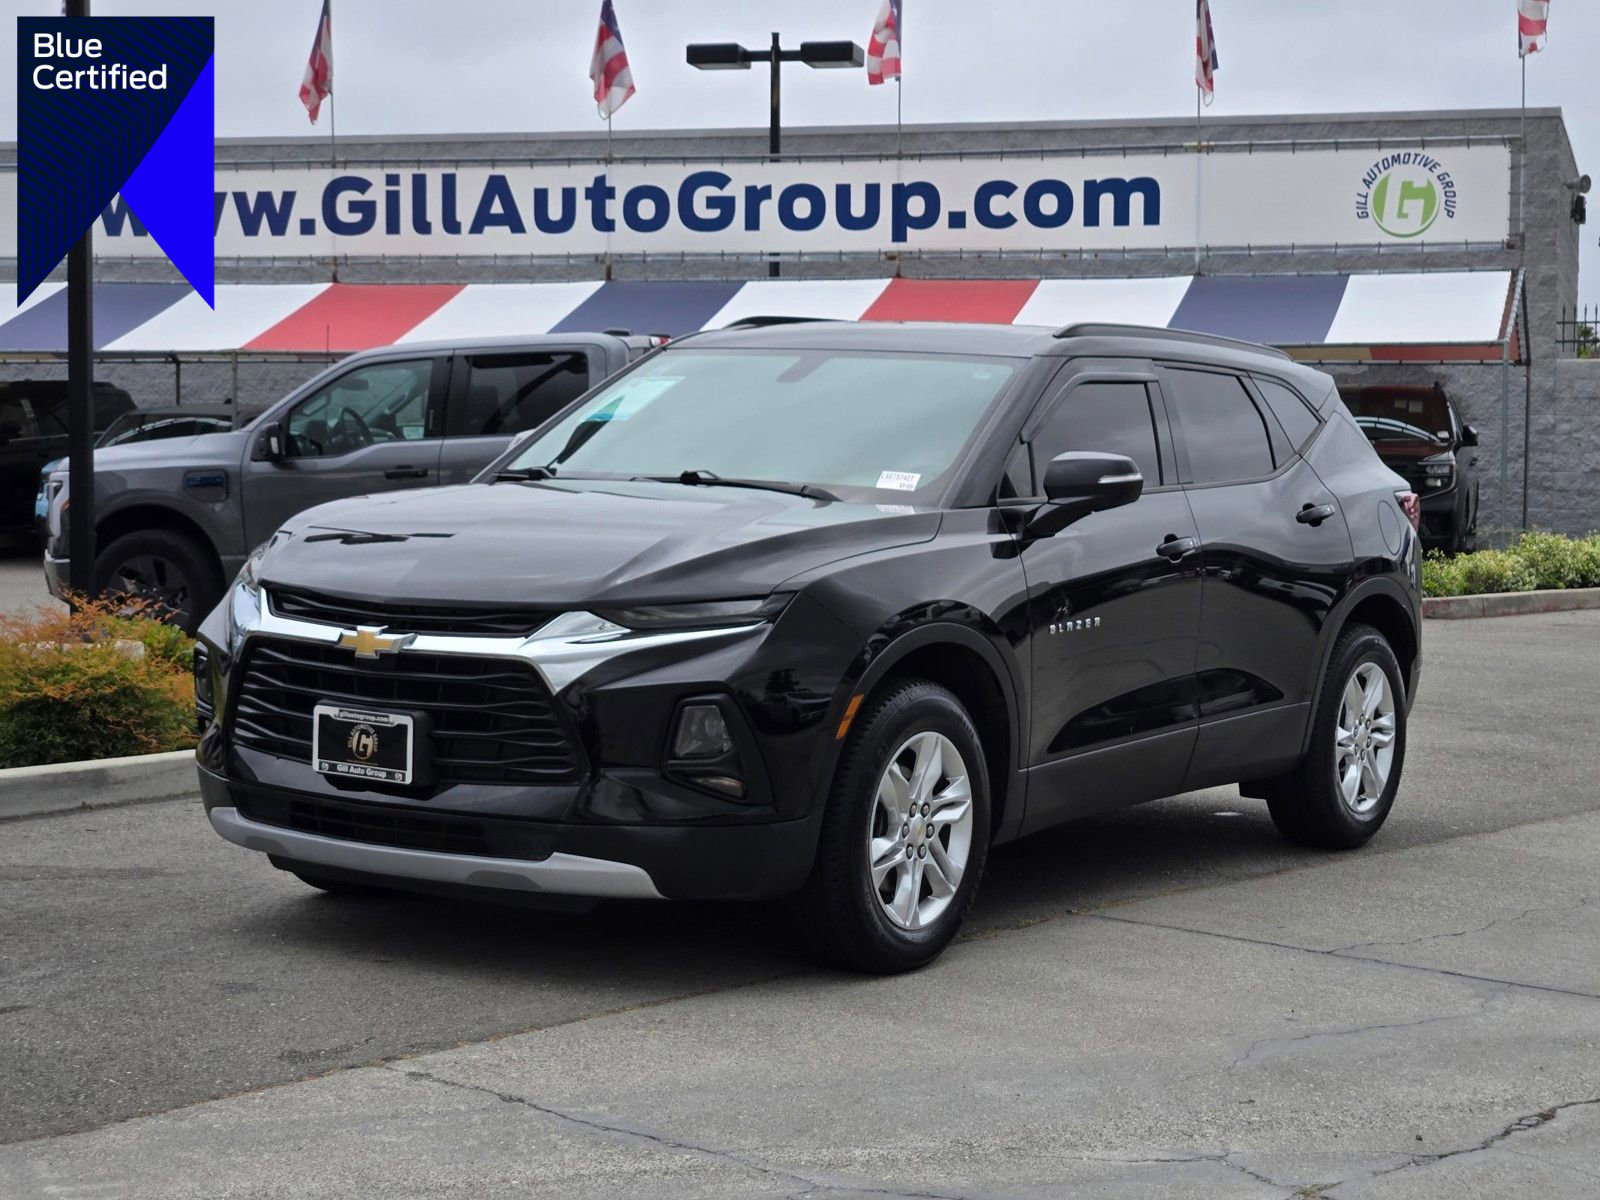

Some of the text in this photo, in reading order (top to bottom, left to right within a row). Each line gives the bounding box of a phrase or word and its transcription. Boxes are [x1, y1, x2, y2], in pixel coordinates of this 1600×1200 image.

[1356, 152, 1457, 220] GILL AUTOMOTIVE GROUP
[1049, 616, 1101, 635] BLAZER
[337, 764, 348, 772] Gill
[349, 766, 365, 775] Auto
[366, 769, 387, 778] Group
